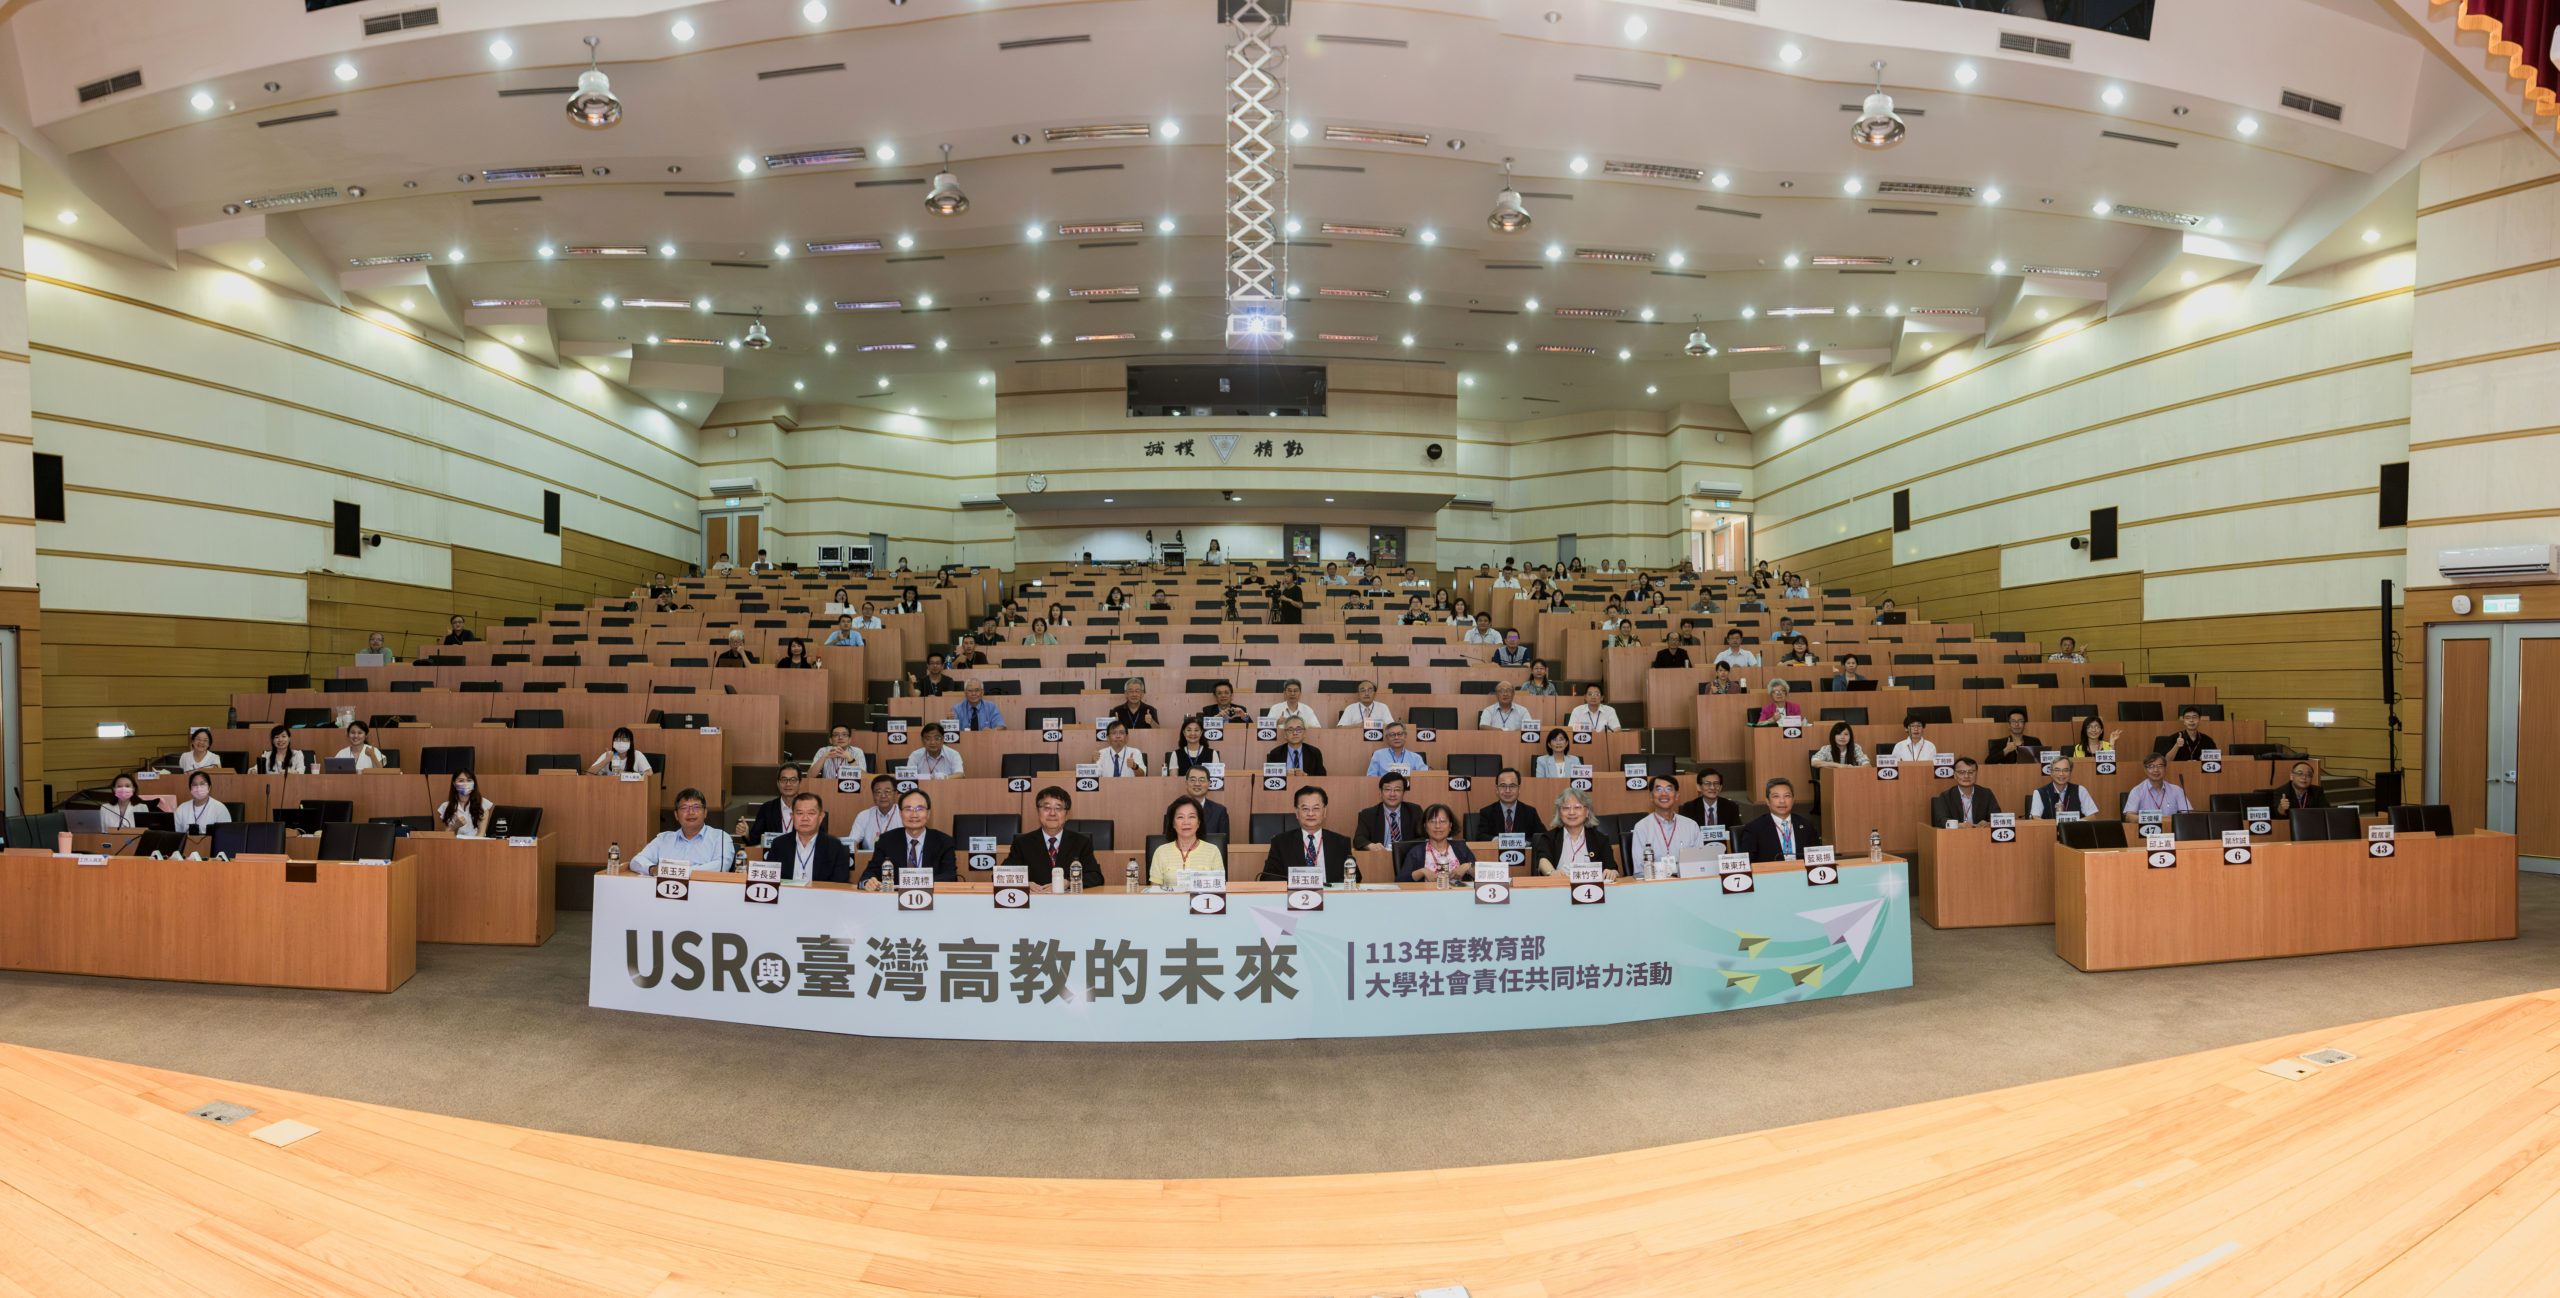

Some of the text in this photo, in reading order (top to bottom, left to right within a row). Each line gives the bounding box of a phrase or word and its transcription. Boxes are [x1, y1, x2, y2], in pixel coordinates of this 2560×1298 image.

[892, 734, 902, 742] 33
[1047, 732, 1058, 740] 35
[1208, 731, 1218, 739] 37
[1368, 731, 1378, 739] 39
[1526, 733, 1535, 741] 41
[1578, 734, 1587, 742] 42
[2101, 764, 2111, 772] 53
[2206, 763, 2216, 771] 54
[1882, 769, 1893, 777] 50
[1939, 768, 1949, 776] 51
[844, 782, 855, 790] 23
[902, 783, 912, 791] 24
[1082, 781, 1093, 789] 26
[1270, 779, 1281, 788] 28
[1454, 780, 1465, 788] 30
[1576, 780, 1586, 789] 31
[1631, 780, 1642, 788] 32
[2144, 827, 2156, 835] 47
[2254, 824, 2266, 832] 48
[1997, 831, 2009, 839] 45
[2375, 845, 2388, 854] 43
[1505, 853, 1519, 863] 20
[2159, 855, 2166, 865] 5
[2234, 851, 2241, 861] 6
[976, 857, 989, 867] 15
[1818, 869, 1827, 880] 9
[1733, 877, 1741, 888] 7
[665, 884, 680, 895] 12
[755, 886, 769, 899] 11
[1488, 887, 1497, 899] 3
[1584, 888, 1593, 899] 4
[908, 893, 923, 906] 10
[1007, 892, 1016, 904] 8
[1301, 894, 1310, 906] 2
[1203, 897, 1212, 909] 1
[1365, 935, 1546, 965] 113年度教育部
[626, 929, 1300, 1006] USR與臺灣高教的未來
[1365, 961, 1673, 999] 大學社會責任共同培力活動
